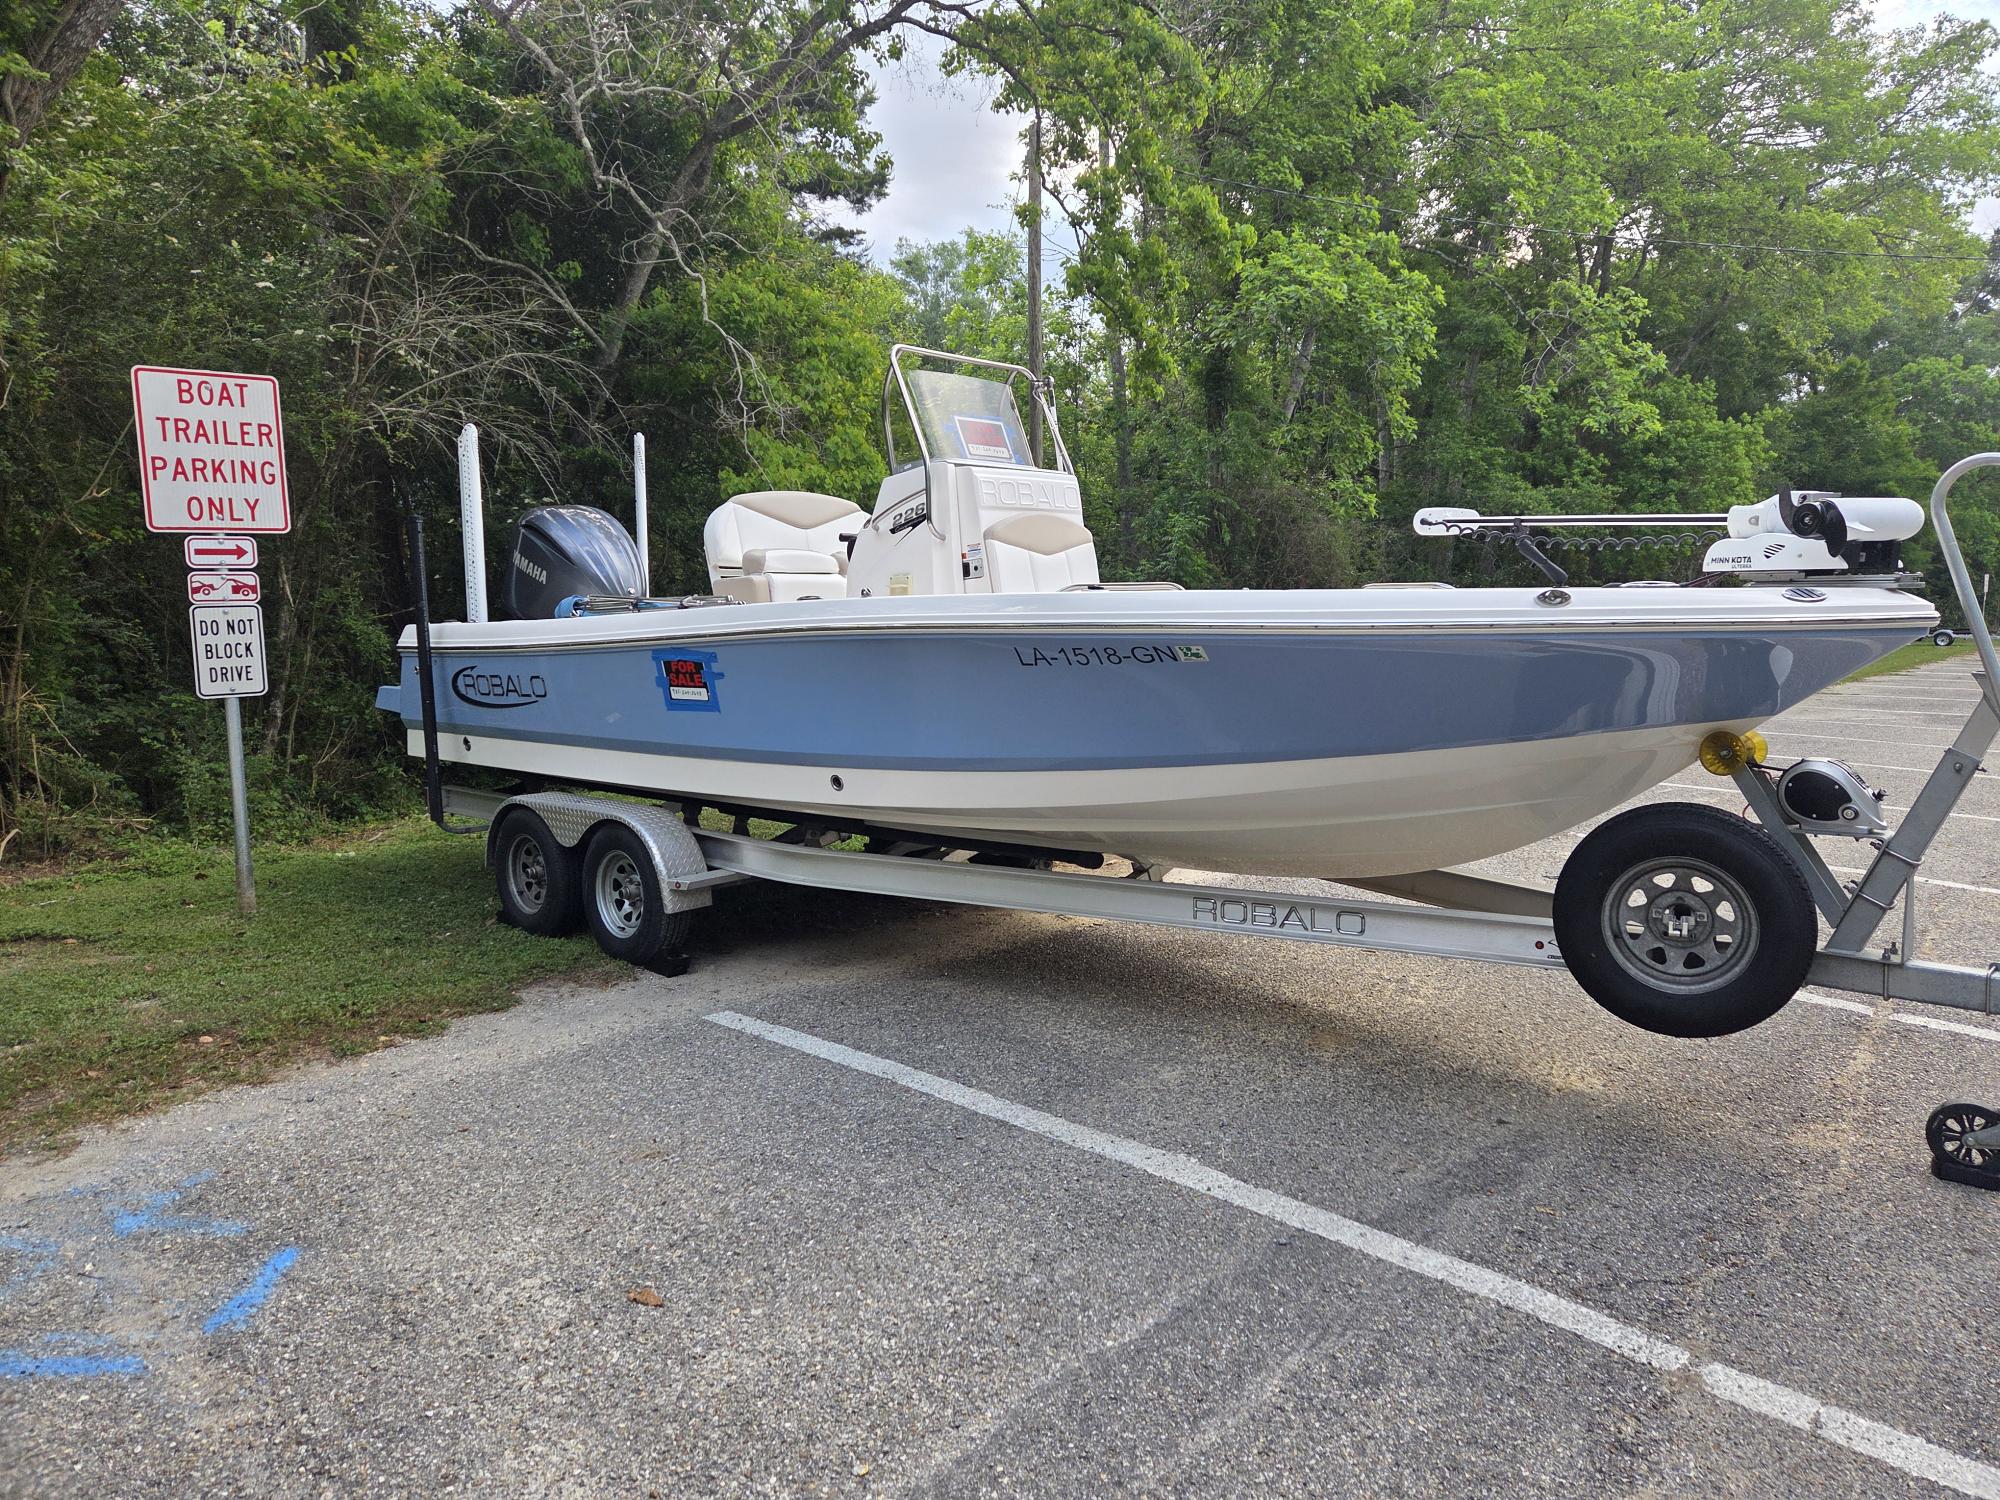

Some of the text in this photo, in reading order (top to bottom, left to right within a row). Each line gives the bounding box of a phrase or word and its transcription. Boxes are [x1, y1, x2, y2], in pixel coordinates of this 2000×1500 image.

[177, 379, 248, 407] BOAT
[156, 417, 273, 447] TRAILER
[151, 457, 276, 485] PARKING
[979, 479, 1080, 510] ROBALO
[186, 497, 260, 521] ONLY
[513, 549, 547, 584] YAMAHA
[200, 619, 254, 636] DO NOT
[205, 642, 254, 659] BLOCK
[1014, 646, 1179, 666] LA-1518-GN
[209, 666, 253, 683] DRIVE
[671, 661, 696, 672] FOR
[463, 674, 547, 697] ROBALO
[669, 672, 704, 686] SALE
[1193, 897, 1366, 936] ROBALO
